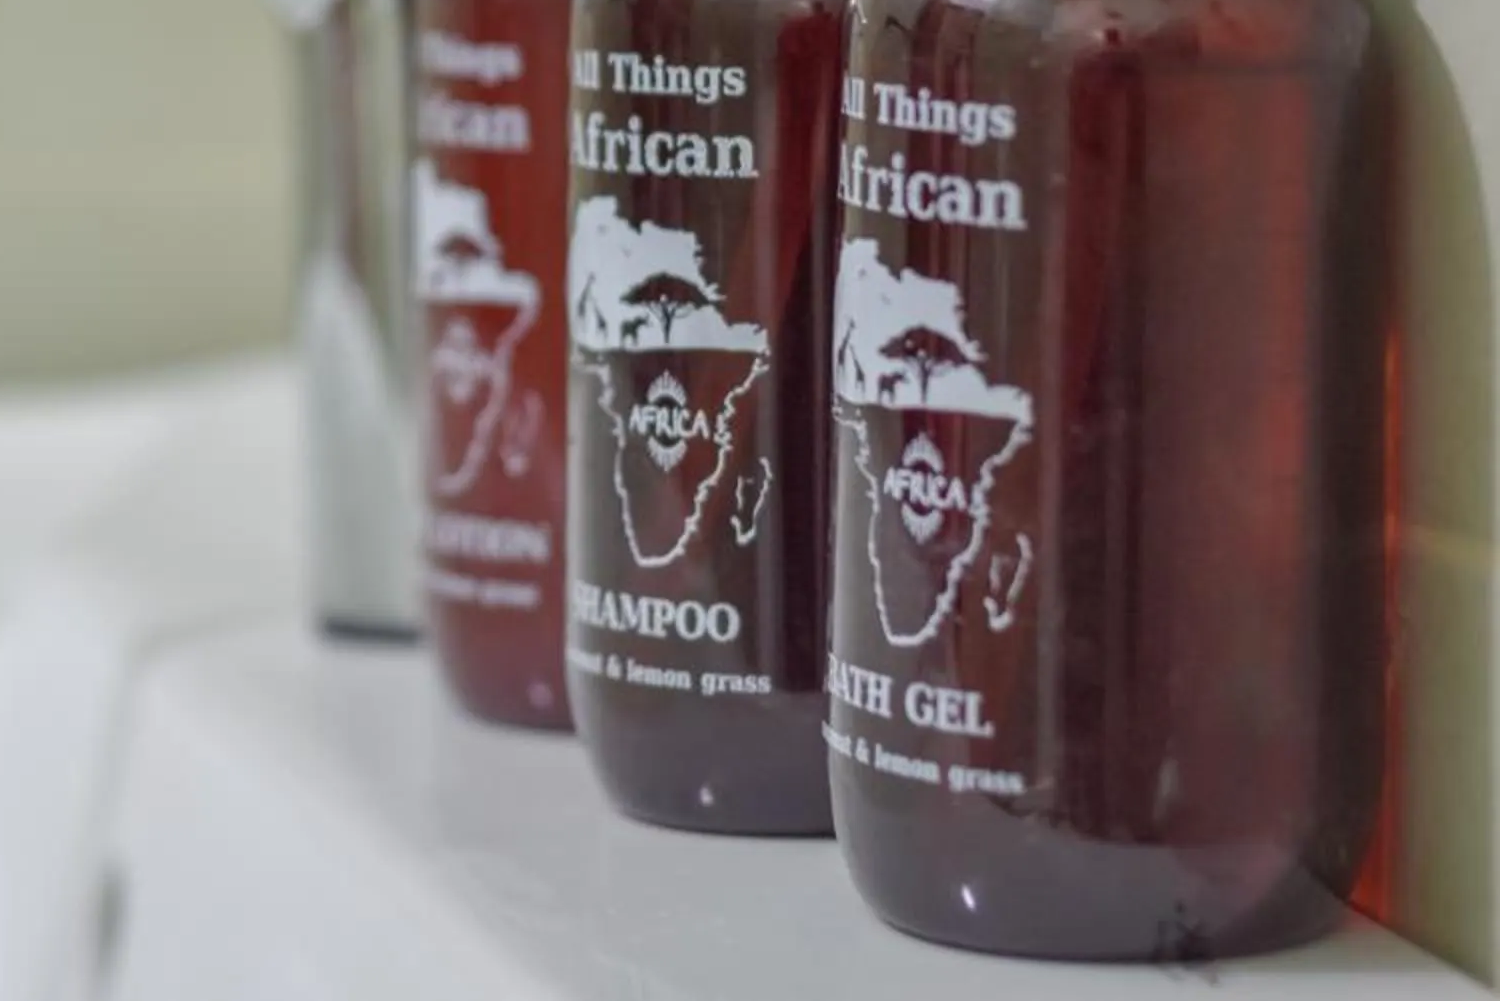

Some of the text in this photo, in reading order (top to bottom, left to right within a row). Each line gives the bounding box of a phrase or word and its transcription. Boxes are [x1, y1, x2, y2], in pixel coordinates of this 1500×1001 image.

[608, 52, 747, 105] Things
[873, 82, 1017, 145] Things
[572, 109, 759, 178] African
[837, 141, 1028, 231] African
[629, 403, 710, 440] AFRICA
[883, 466, 967, 512] AFRICA
[572, 578, 741, 643] SHAMPOO
[626, 657, 692, 690] lemon
[701, 672, 772, 697] grass
[904, 682, 995, 739] GEL
[874, 742, 941, 785] lemon
[948, 764, 1026, 795] grass
